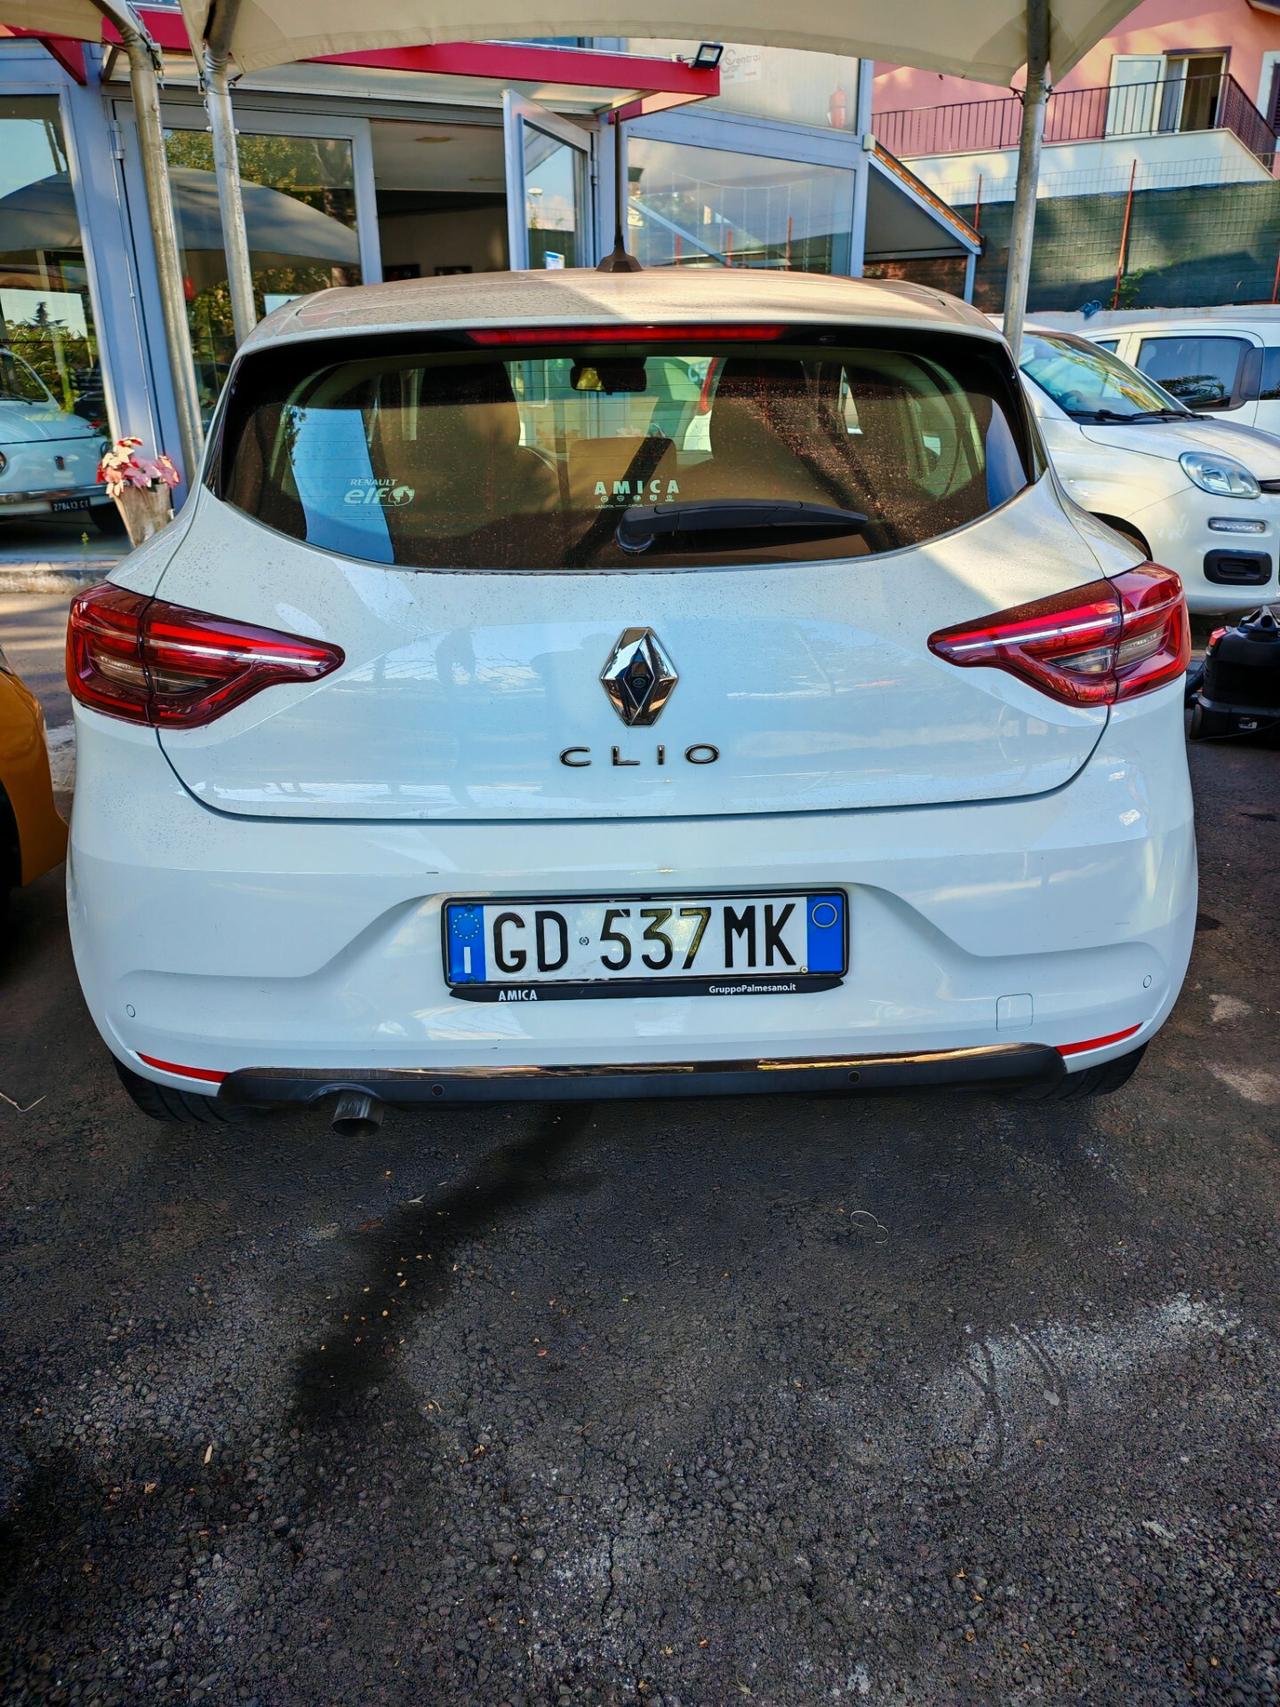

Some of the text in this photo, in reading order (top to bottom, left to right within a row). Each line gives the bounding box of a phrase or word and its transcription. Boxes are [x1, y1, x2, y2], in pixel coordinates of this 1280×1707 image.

[350, 478, 398, 486] RENAULT
[594, 479, 680, 496] AMICA
[343, 487, 390, 504] elf
[559, 743, 720, 767] CLIO
[463, 946, 472, 974] I
[498, 989, 538, 1001] AMICA
[708, 982, 797, 995] GruppoPalmesano.it
